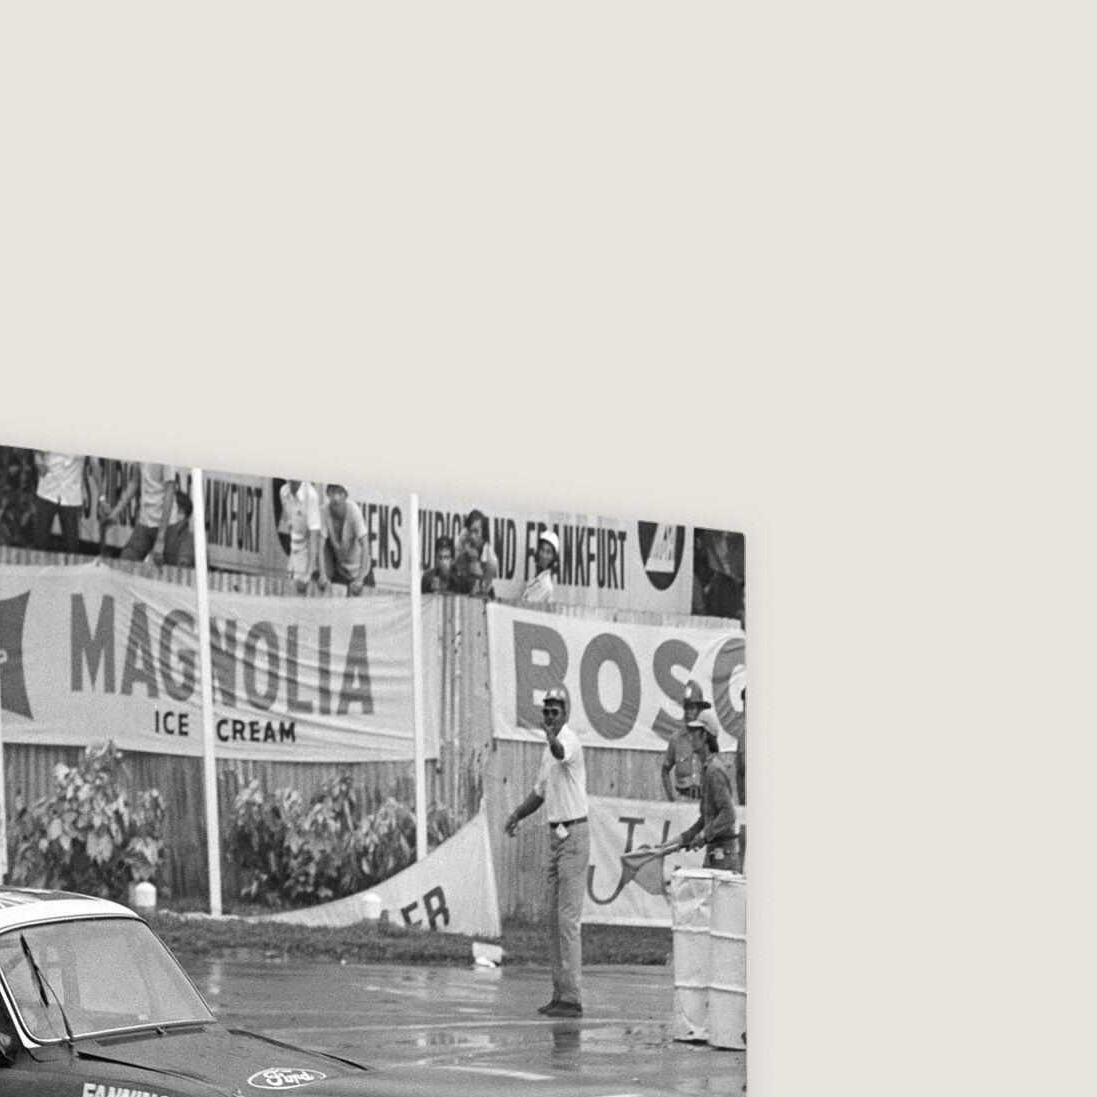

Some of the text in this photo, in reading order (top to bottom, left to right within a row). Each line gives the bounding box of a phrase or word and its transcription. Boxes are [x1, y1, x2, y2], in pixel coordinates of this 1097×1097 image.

[483, 516, 516, 580] ND
[70, 593, 375, 715] MAGNOLIA
[155, 710, 297, 743] ICE CREAM
[264, 1067, 315, 1087] Ford
